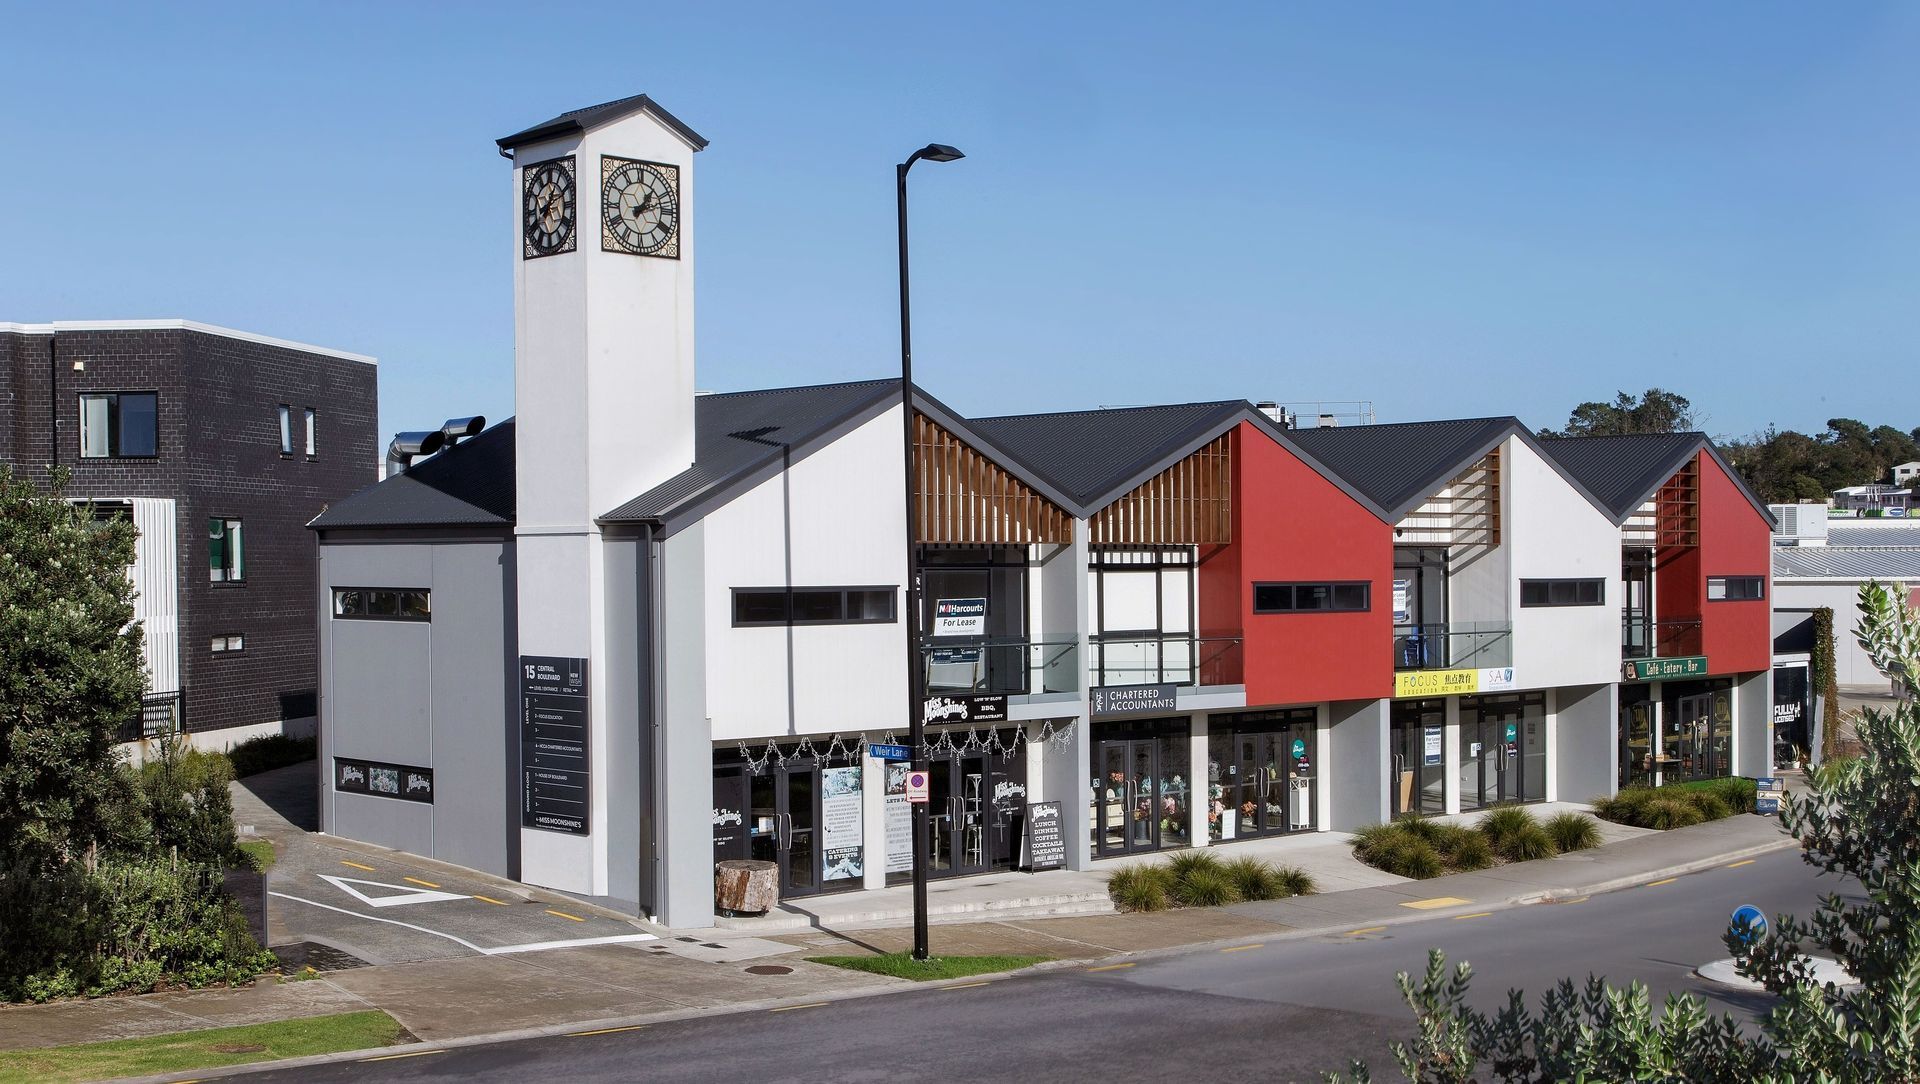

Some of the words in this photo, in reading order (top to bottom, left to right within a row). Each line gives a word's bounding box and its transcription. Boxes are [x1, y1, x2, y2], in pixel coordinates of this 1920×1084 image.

[952, 604, 984, 612] Harcourts
[943, 618, 956, 626] For
[957, 618, 976, 626] Lease
[524, 665, 536, 679] 15
[1646, 662, 1659, 676] Café
[1663, 662, 1682, 674] Eatery
[1688, 660, 1698, 672] Bar
[1404, 675, 1438, 687] FOCUS
[1110, 689, 1159, 700] CHARTERED
[1110, 699, 1174, 710] ACCOUNTANTS
[1774, 704, 1794, 716] FULLY
[875, 746, 890, 756] Weir
[892, 747, 908, 757] Lane
[1032, 847, 1065, 856] TAKEAWAY
